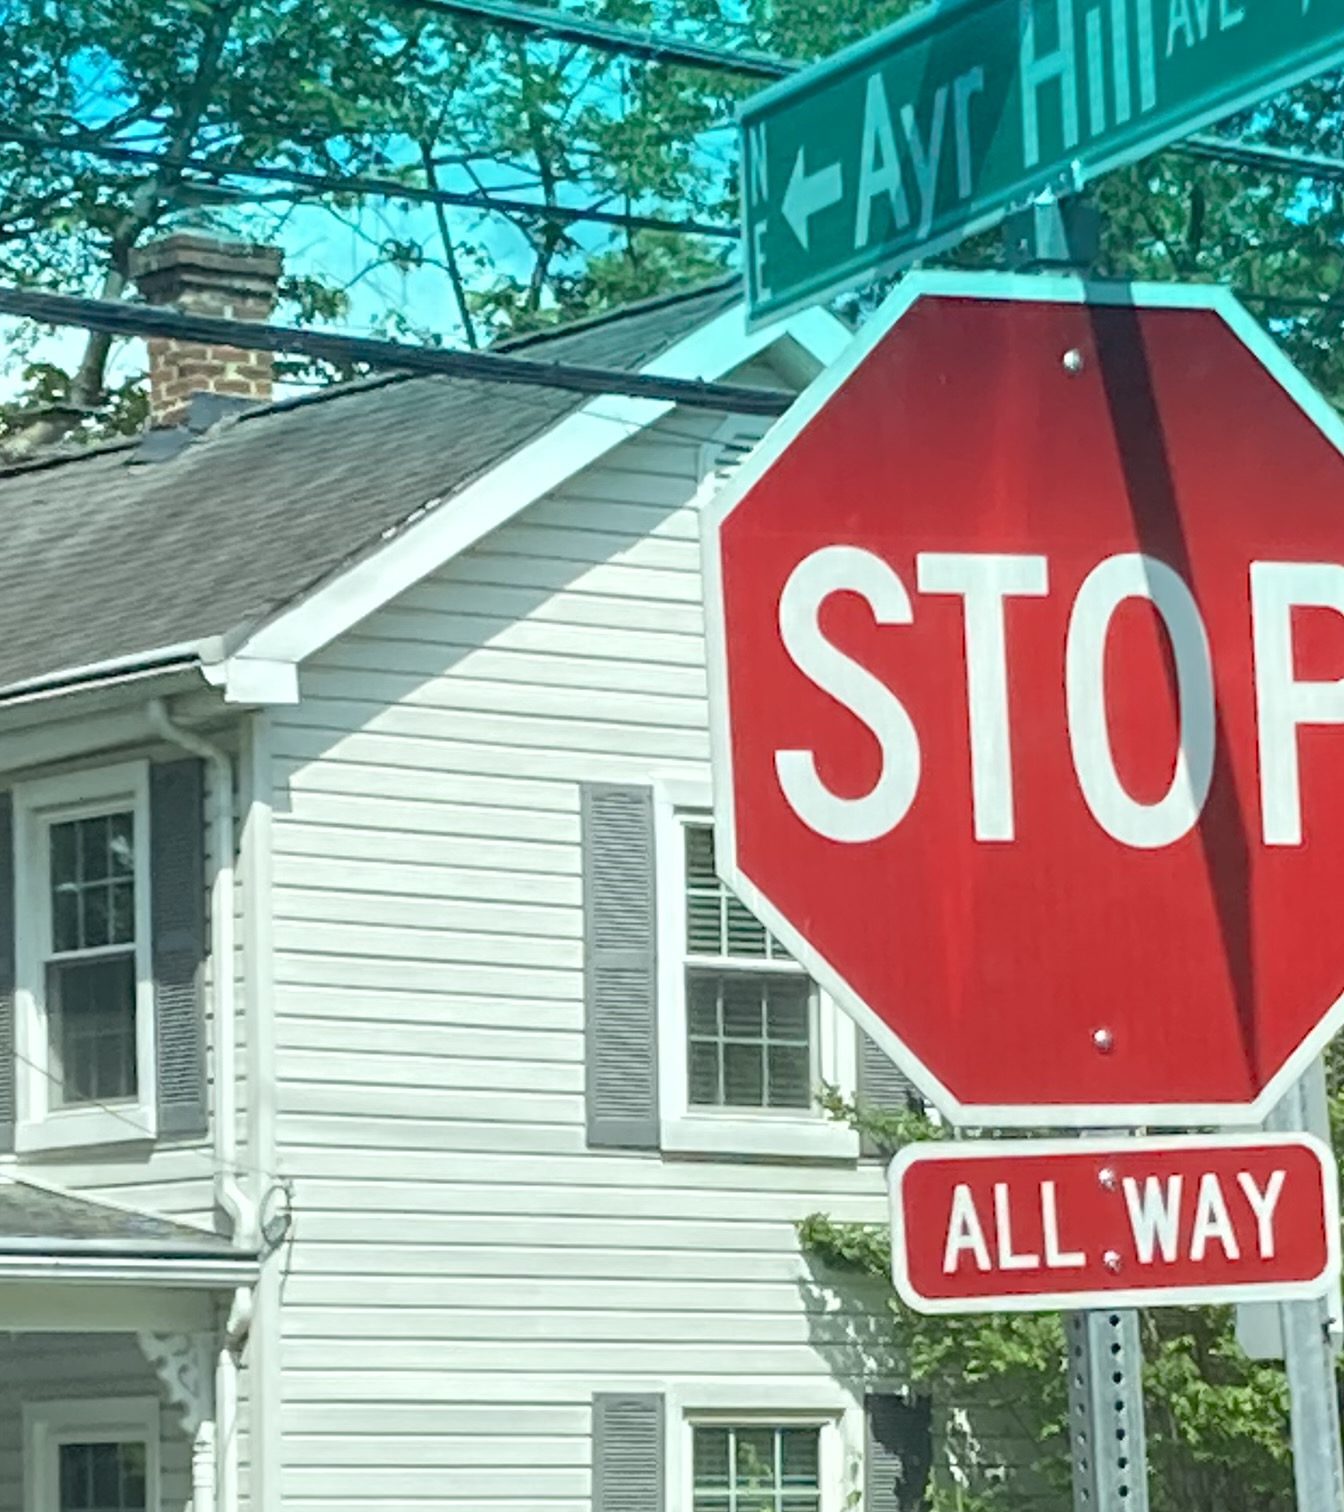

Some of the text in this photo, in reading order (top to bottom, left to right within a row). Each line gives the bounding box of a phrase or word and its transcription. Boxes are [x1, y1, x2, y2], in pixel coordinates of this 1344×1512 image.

[854, 65, 984, 249] Ayr
[1019, 0, 1156, 169] Hill
[942, 1169, 1287, 1274] ALL WAY
